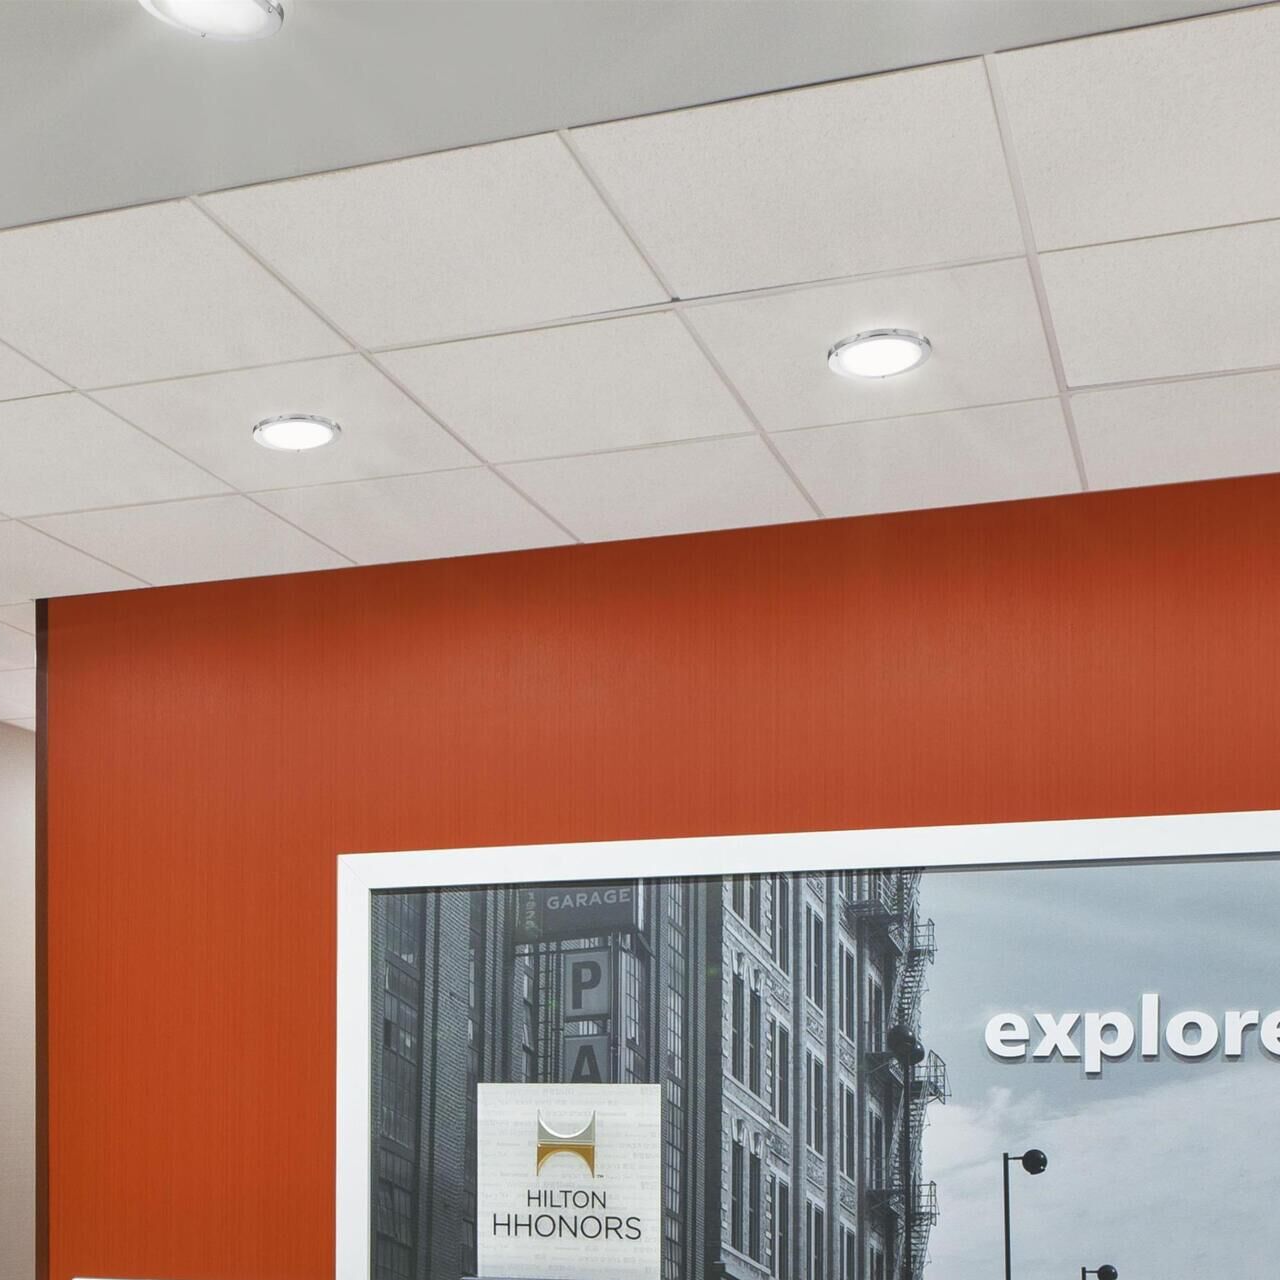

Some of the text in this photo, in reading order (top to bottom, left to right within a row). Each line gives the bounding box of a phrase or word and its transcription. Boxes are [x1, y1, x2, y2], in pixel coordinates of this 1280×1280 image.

[546, 888, 631, 910] GARAGE
[527, 1189, 607, 1209] HILTON
[493, 1213, 642, 1240] HHONORS
